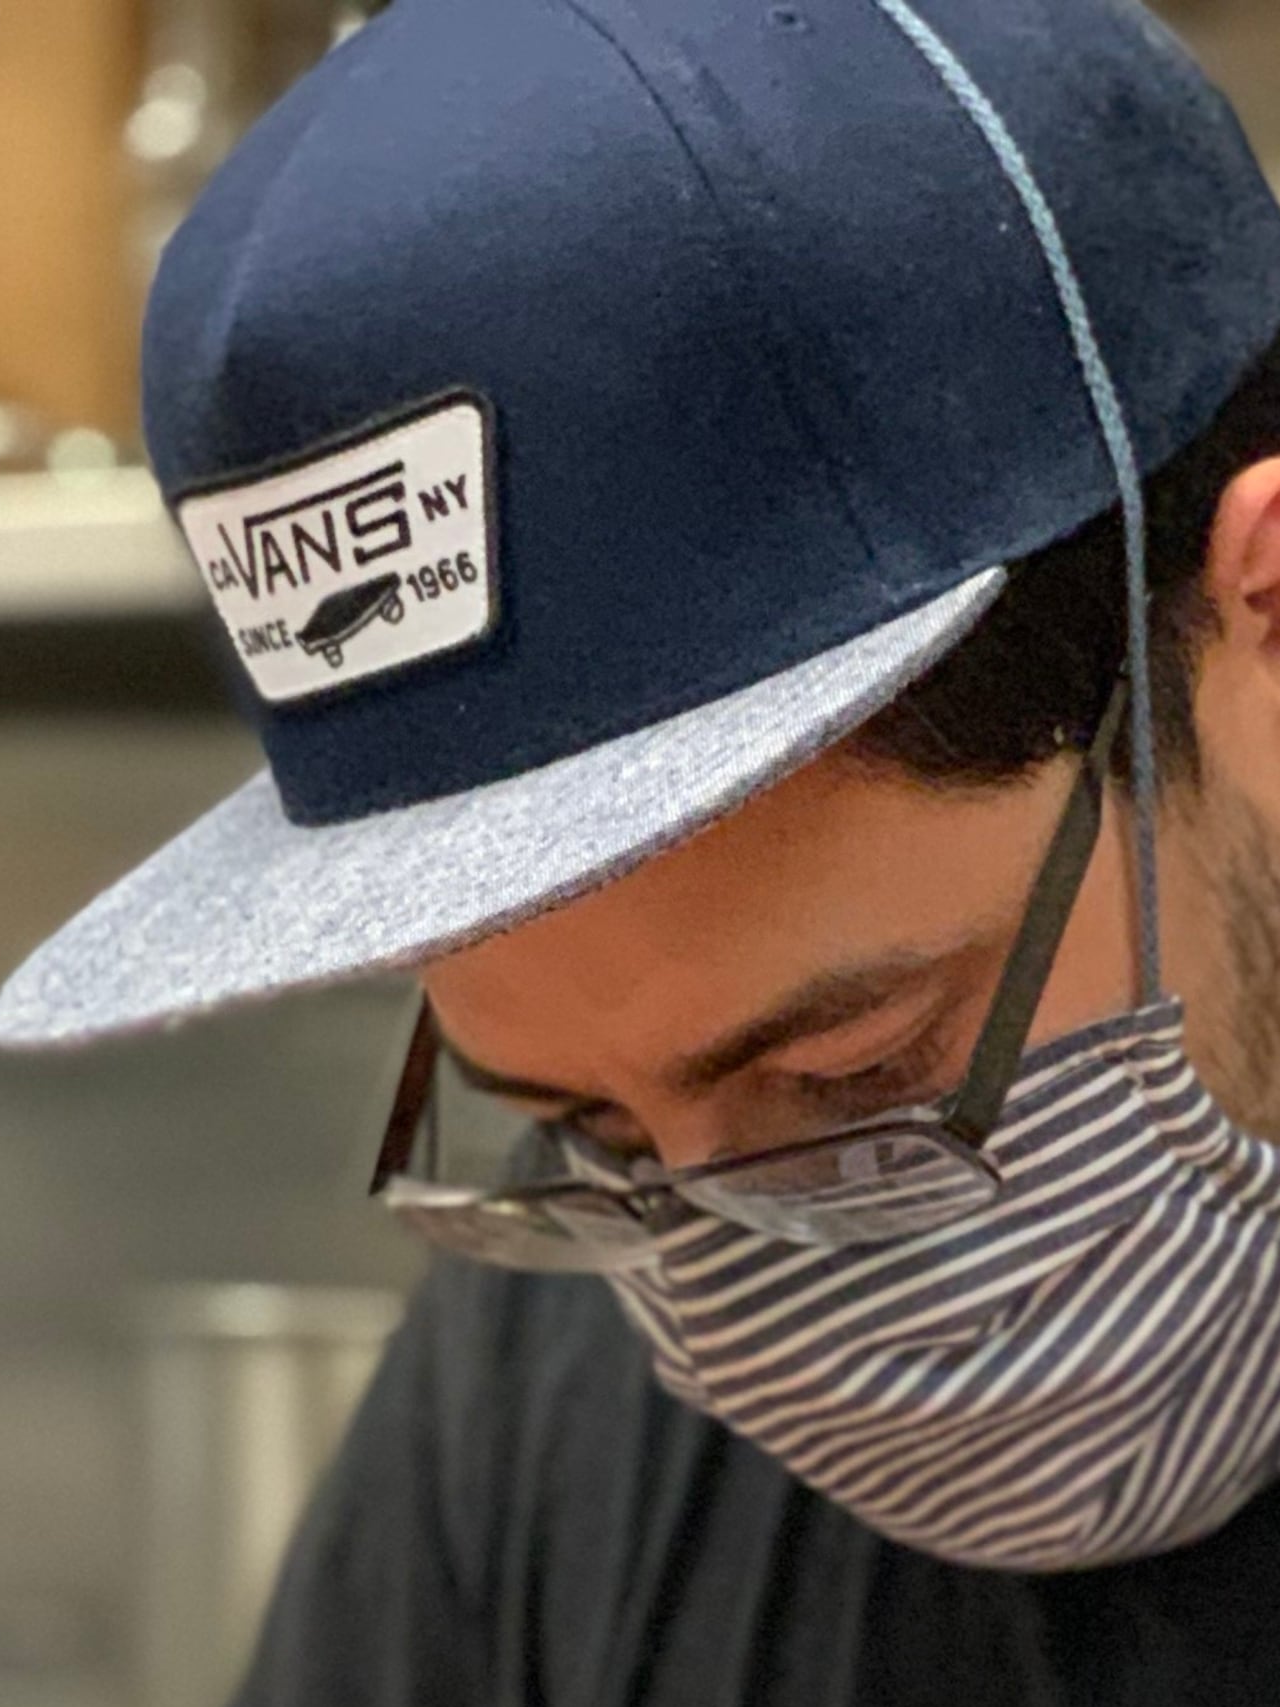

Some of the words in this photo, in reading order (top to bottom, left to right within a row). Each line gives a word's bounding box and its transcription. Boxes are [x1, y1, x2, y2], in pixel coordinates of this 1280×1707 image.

[218, 460, 412, 600] VANS
[418, 474, 469, 522] NY
[209, 557, 239, 592] CA
[239, 620, 294, 657] SINCE
[406, 552, 478, 602] 1966
